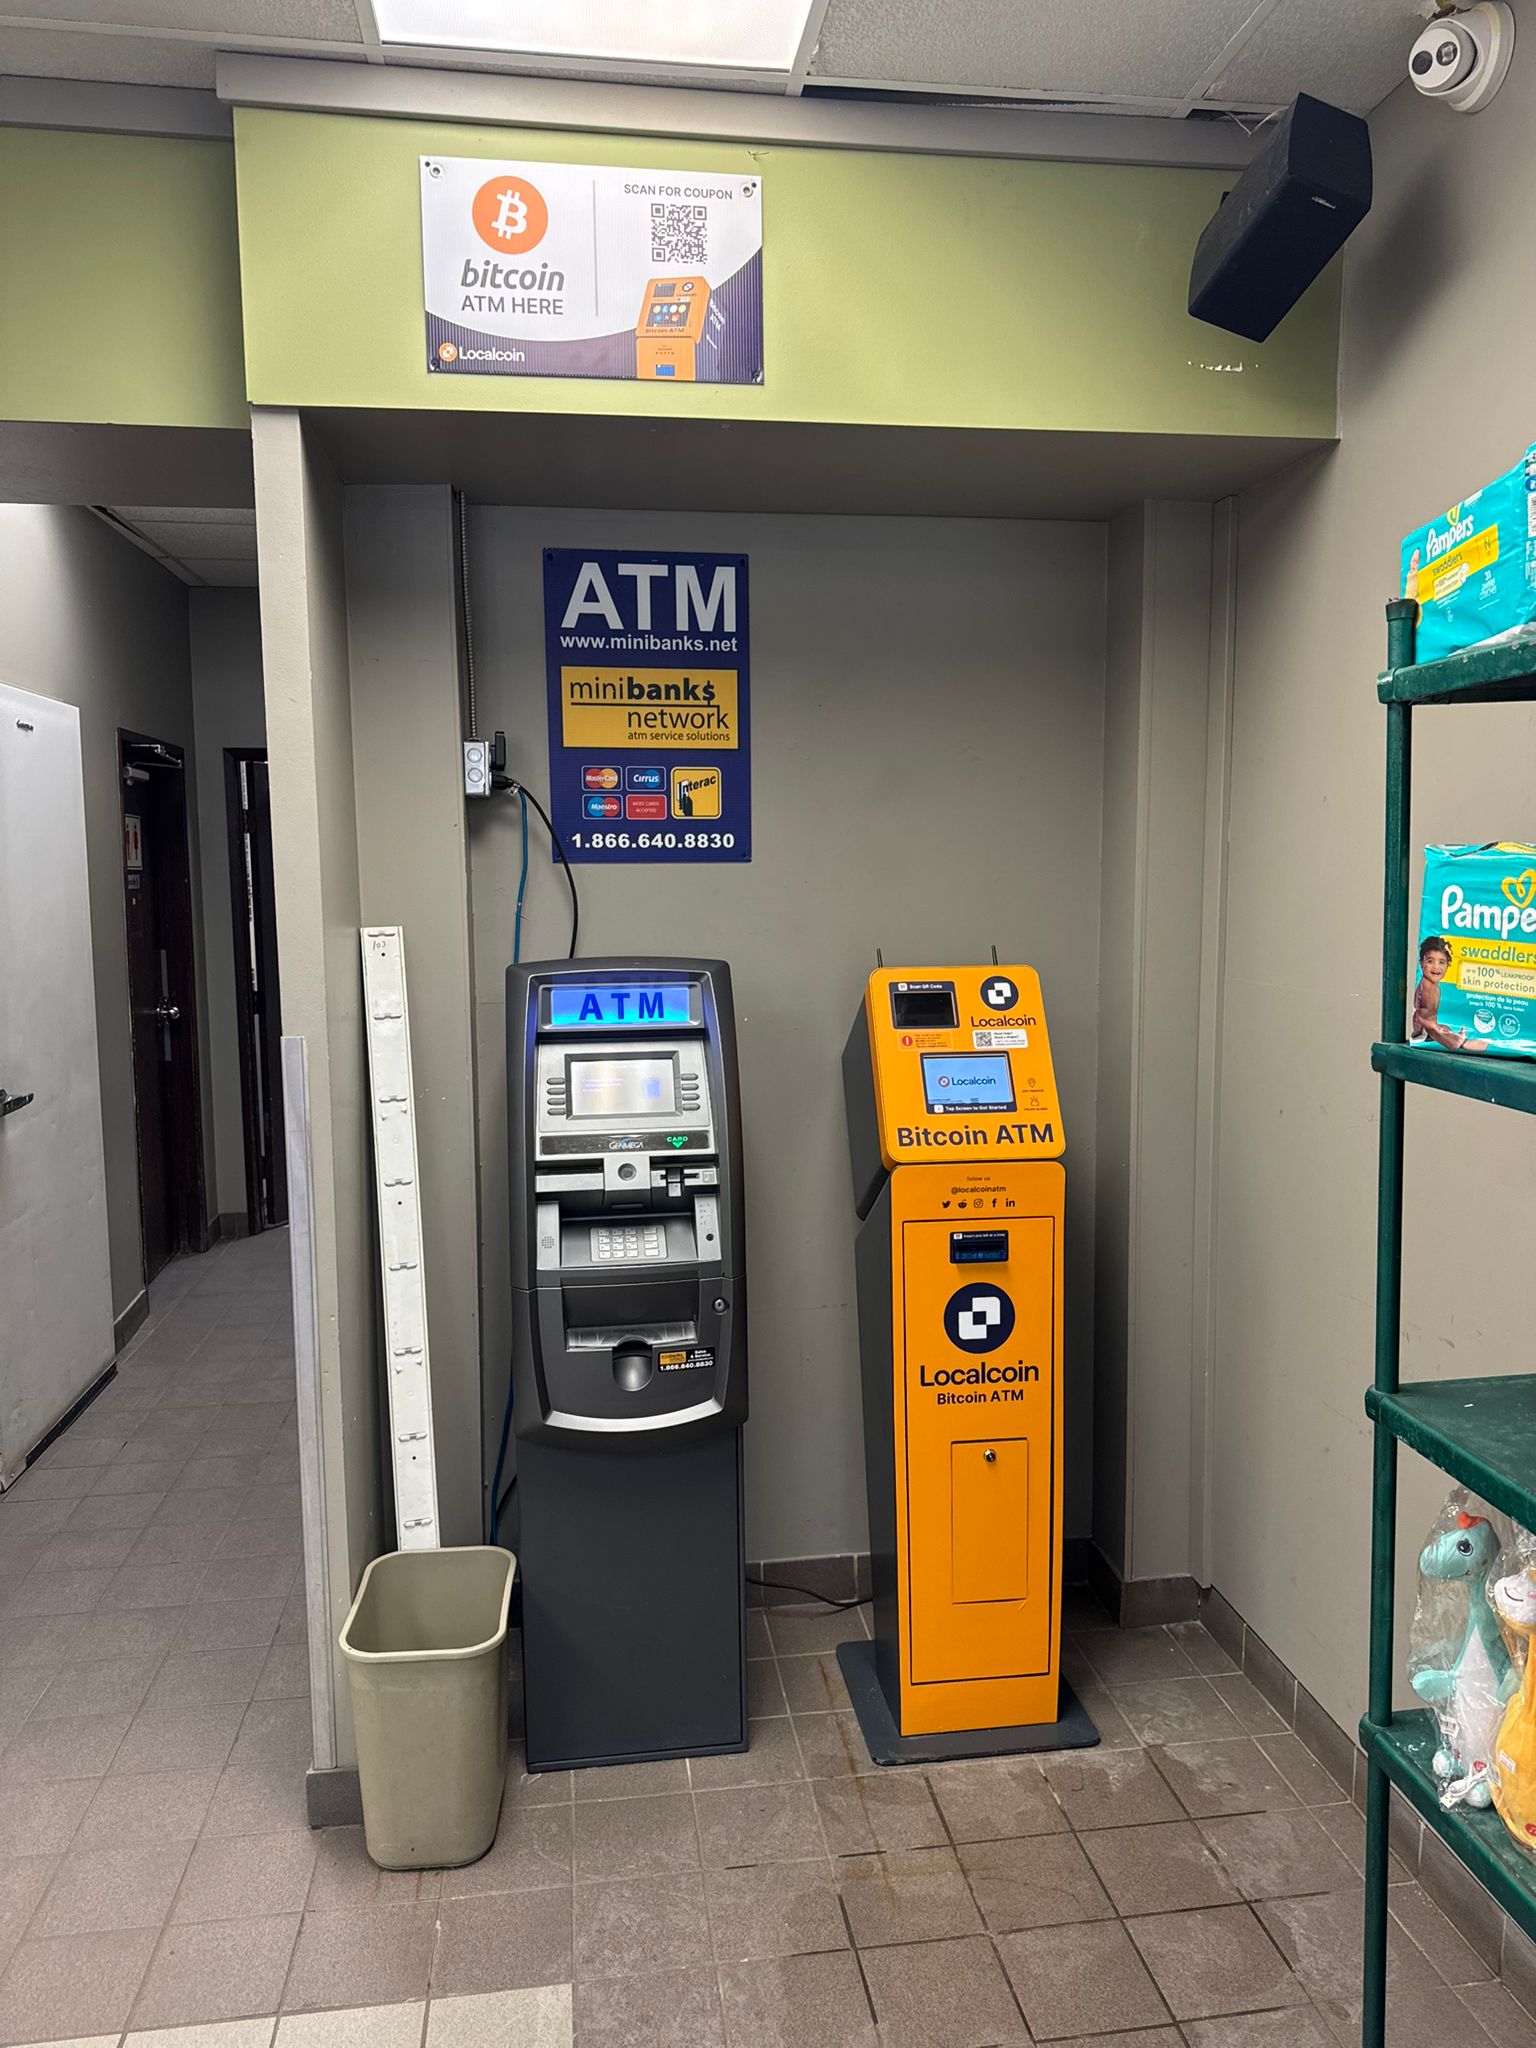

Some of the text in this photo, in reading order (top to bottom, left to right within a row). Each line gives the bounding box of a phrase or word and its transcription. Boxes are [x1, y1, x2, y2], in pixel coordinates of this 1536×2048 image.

[624, 183, 733, 200] SCAN FOR COUPON
[460, 259, 565, 291] bitcoin
[461, 295, 564, 315] ATM HERE
[459, 346, 525, 363] Localcoin
[1426, 514, 1475, 562] Pampers
[1433, 552, 1463, 577] swaddlers
[560, 562, 737, 632] ATM
[560, 634, 738, 652] www.minibanks.net
[627, 705, 730, 729] network
[628, 731, 730, 742] atm service solutions
[585, 774, 618, 783] MasterCard
[633, 774, 660, 783] Cirrus
[678, 776, 717, 797] Interac
[590, 803, 618, 811] Maestro
[571, 832, 736, 849] 1.866.640.8830
[1441, 885, 1536, 939] Pampe
[1462, 976, 1535, 993] skin protection
[1501, 972, 1535, 981] LEAKPROOF
[579, 991, 665, 1021] ATM
[1466, 993, 1529, 1006] protection de la peau
[971, 1015, 1037, 1028] Localcoin
[951, 1076, 996, 1086] Localcoin
[897, 1123, 1055, 1147] Bitcoin ATM
[951, 1185, 1007, 1195] @localcoinatm
[920, 1360, 1039, 1387] Localcoin
[937, 1389, 1024, 1405] Bitcoin ATM
